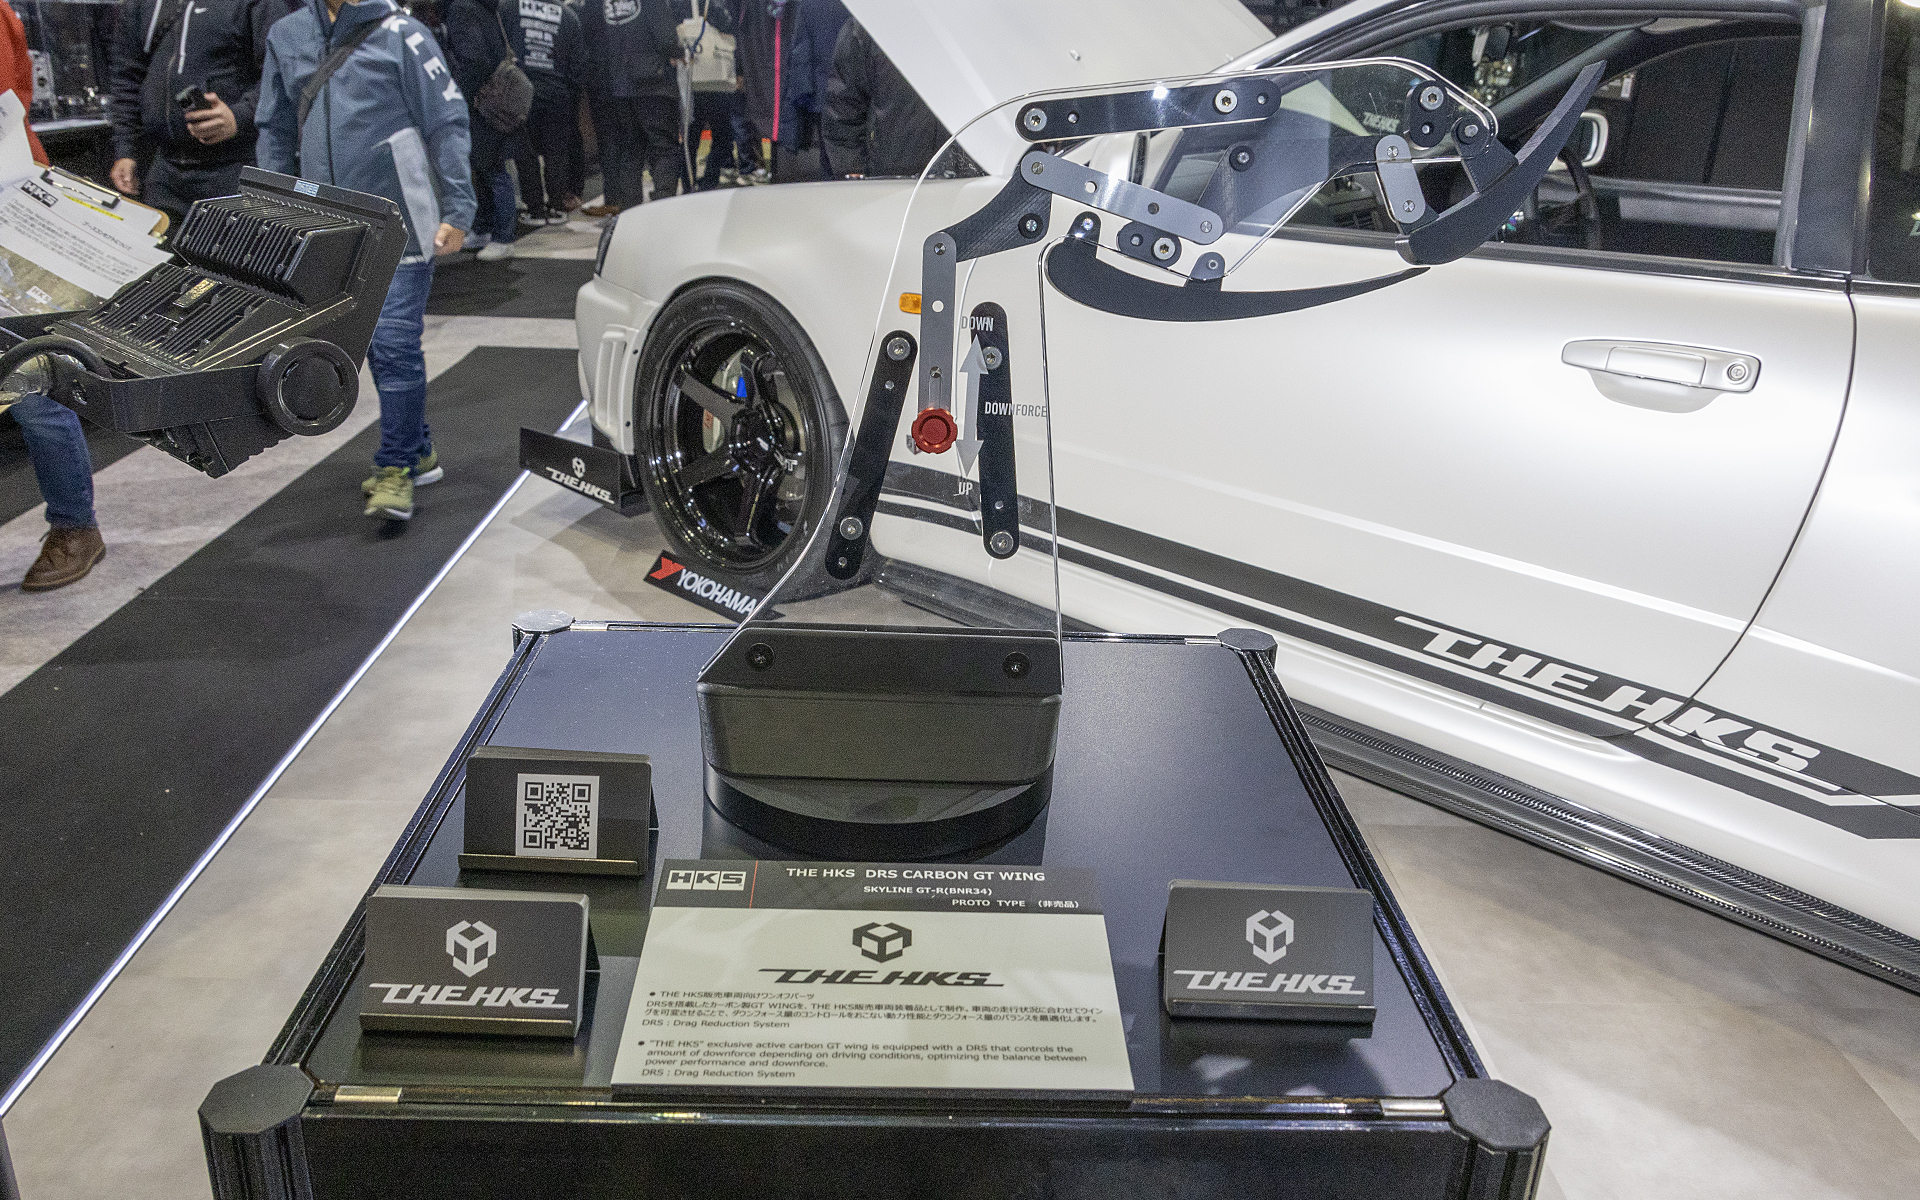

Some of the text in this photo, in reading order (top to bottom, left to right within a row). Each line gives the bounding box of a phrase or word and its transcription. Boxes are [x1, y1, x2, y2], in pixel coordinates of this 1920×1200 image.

[381, 0, 463, 101] KLEY
[21, 180, 58, 208] HKS
[961, 316, 994, 331] DOWN
[985, 402, 1047, 417] DOWNFORCE
[546, 466, 615, 504] THE HKS
[958, 482, 973, 496] UP
[677, 568, 757, 616] YOKOHAMA
[1394, 616, 1832, 782] THE HKS
[668, 870, 745, 889] HKS
[786, 868, 1045, 881] THE HKS DRS CARBON GT WING
[863, 886, 993, 896] SKYLINE GT-R(BNR34)
[952, 899, 991, 907] PROTO
[759, 968, 1004, 987] THE HKS
[1173, 970, 1366, 995] THE HKS
[369, 983, 569, 1009] THE HKS
[673, 1020, 697, 1028] Drag
[753, 1020, 790, 1028] System
[755, 1041, 786, 1049] active
[789, 1041, 823, 1049] carbon
[826, 1042, 841, 1050] GT
[844, 1042, 868, 1051] wing
[882, 1044, 928, 1052] equipped
[1014, 1045, 1053, 1053] controls
[1056, 1045, 1073, 1053] the
[647, 1049, 686, 1057] amount
[689, 1049, 700, 1057] of
[703, 1049, 756, 1058] downforce
[759, 1050, 812, 1059] depending
[832, 1050, 866, 1060] driving
[869, 1051, 924, 1061] conditions,
[927, 1052, 980, 1062] optimizing
[983, 1052, 999, 1061] the
[1002, 1053, 1041, 1061] balance
[1044, 1053, 1087, 1062] between
[680, 1058, 746, 1068] performance
[749, 1059, 769, 1067] and
[772, 1059, 828, 1067] downforce.
[673, 1069, 699, 1078] Drag
[701, 1069, 754, 1077] Reduction
[756, 1070, 795, 1079] System
